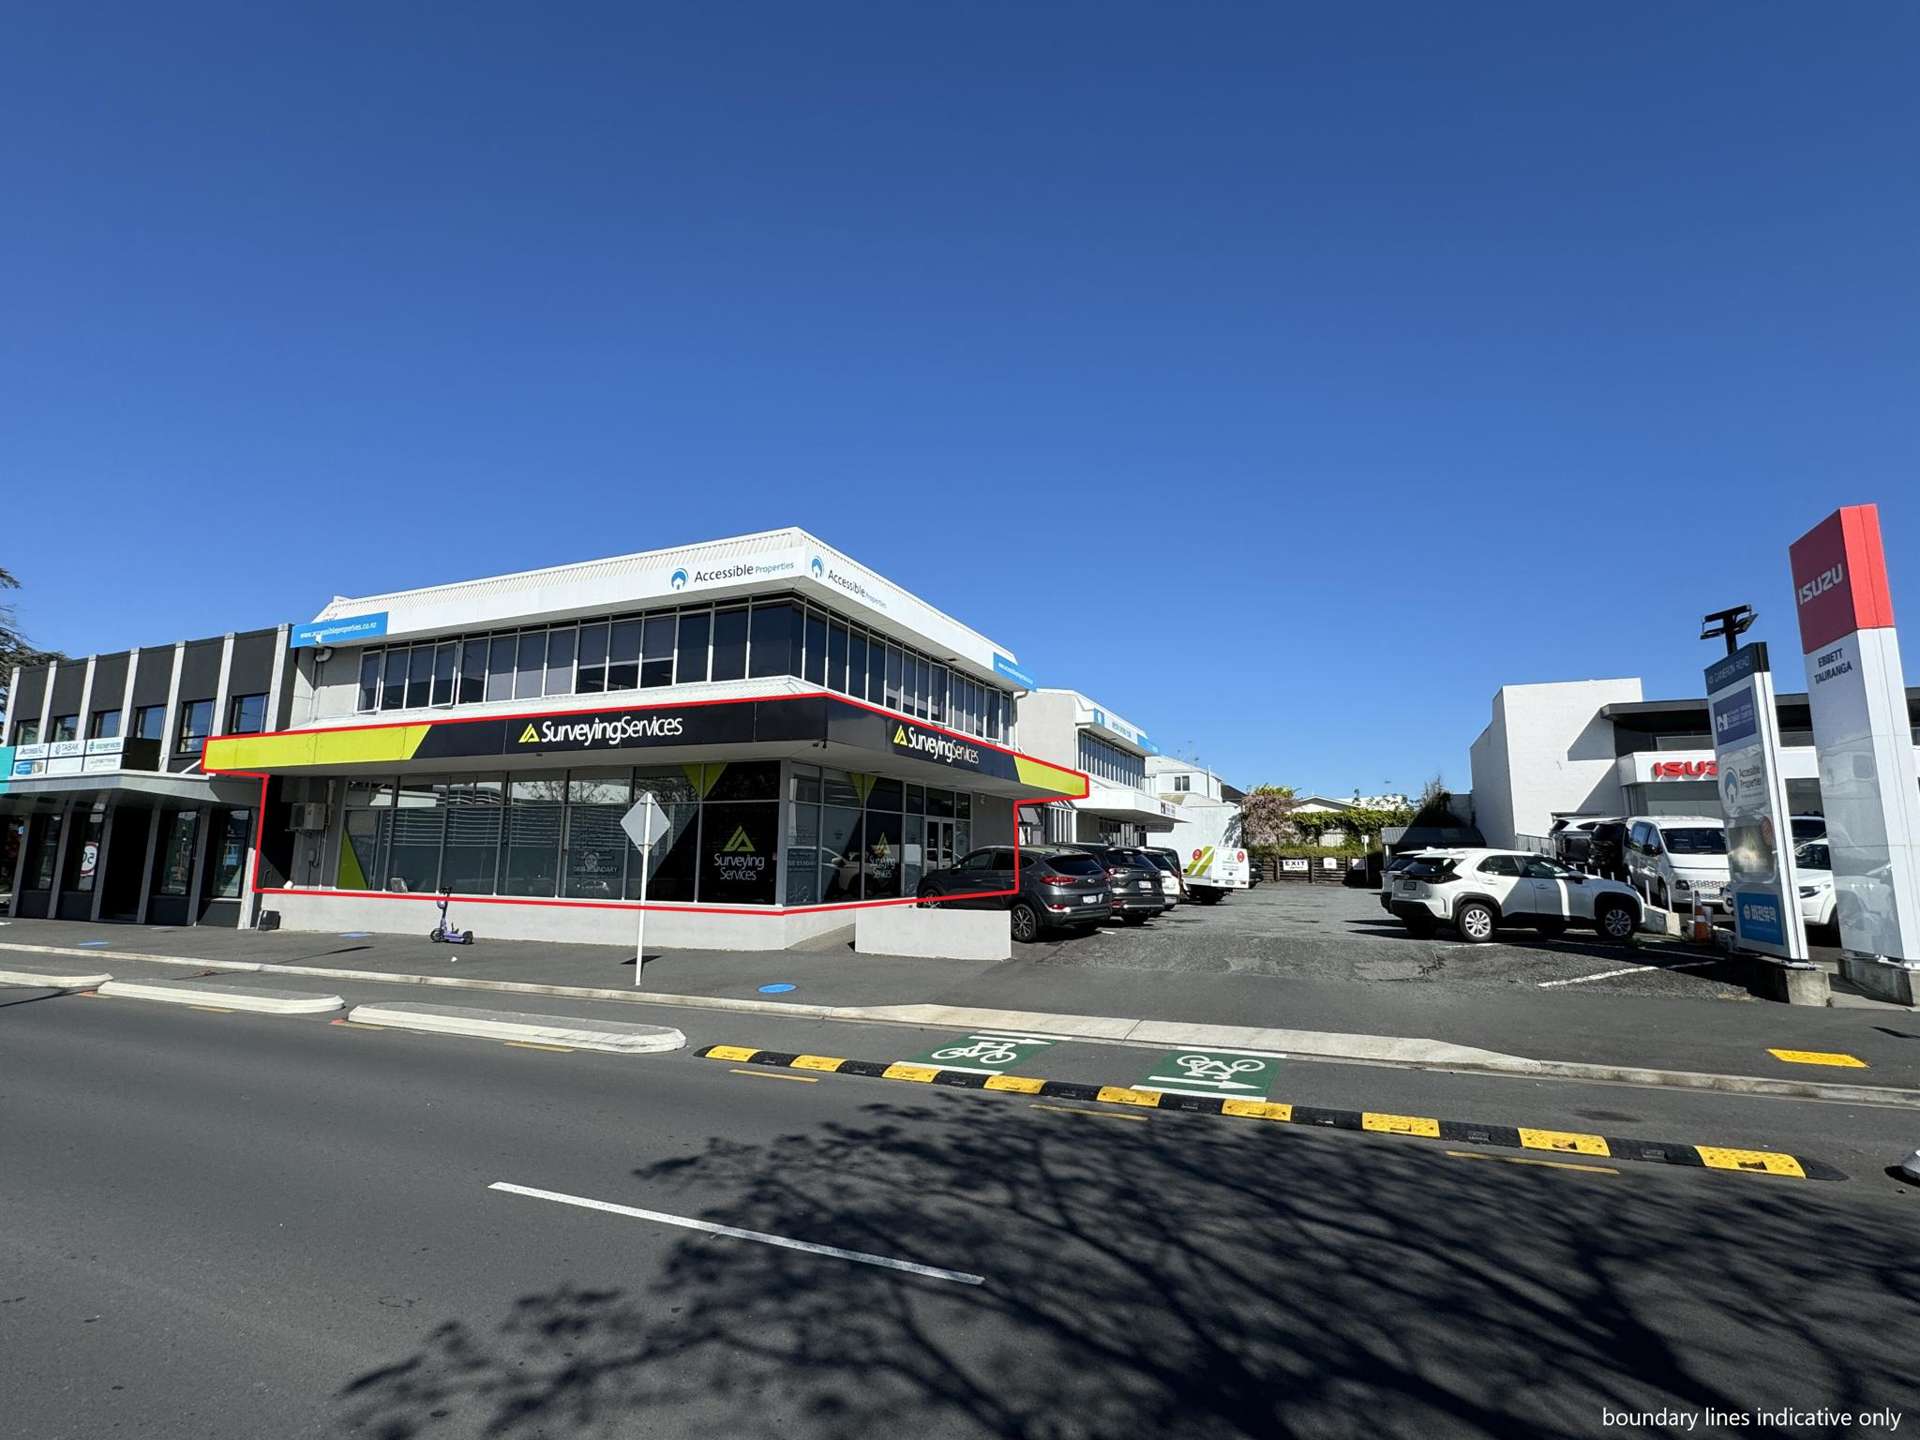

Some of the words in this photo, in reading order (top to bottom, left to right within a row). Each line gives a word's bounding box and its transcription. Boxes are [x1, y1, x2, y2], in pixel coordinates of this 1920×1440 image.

[694, 564, 754, 583] Accessible
[755, 561, 794, 574] Properties
[828, 570, 866, 597] Accessible
[1798, 564, 1843, 605] ISUZU
[1817, 648, 1843, 668] EBBETT
[1814, 661, 1853, 684] TAURANGA
[541, 716, 683, 746] SurveyingServices
[908, 726, 980, 765] SurveyingServices
[1652, 761, 1718, 778] ISUZ
[713, 853, 765, 870] Surveying
[720, 867, 757, 881] Services
